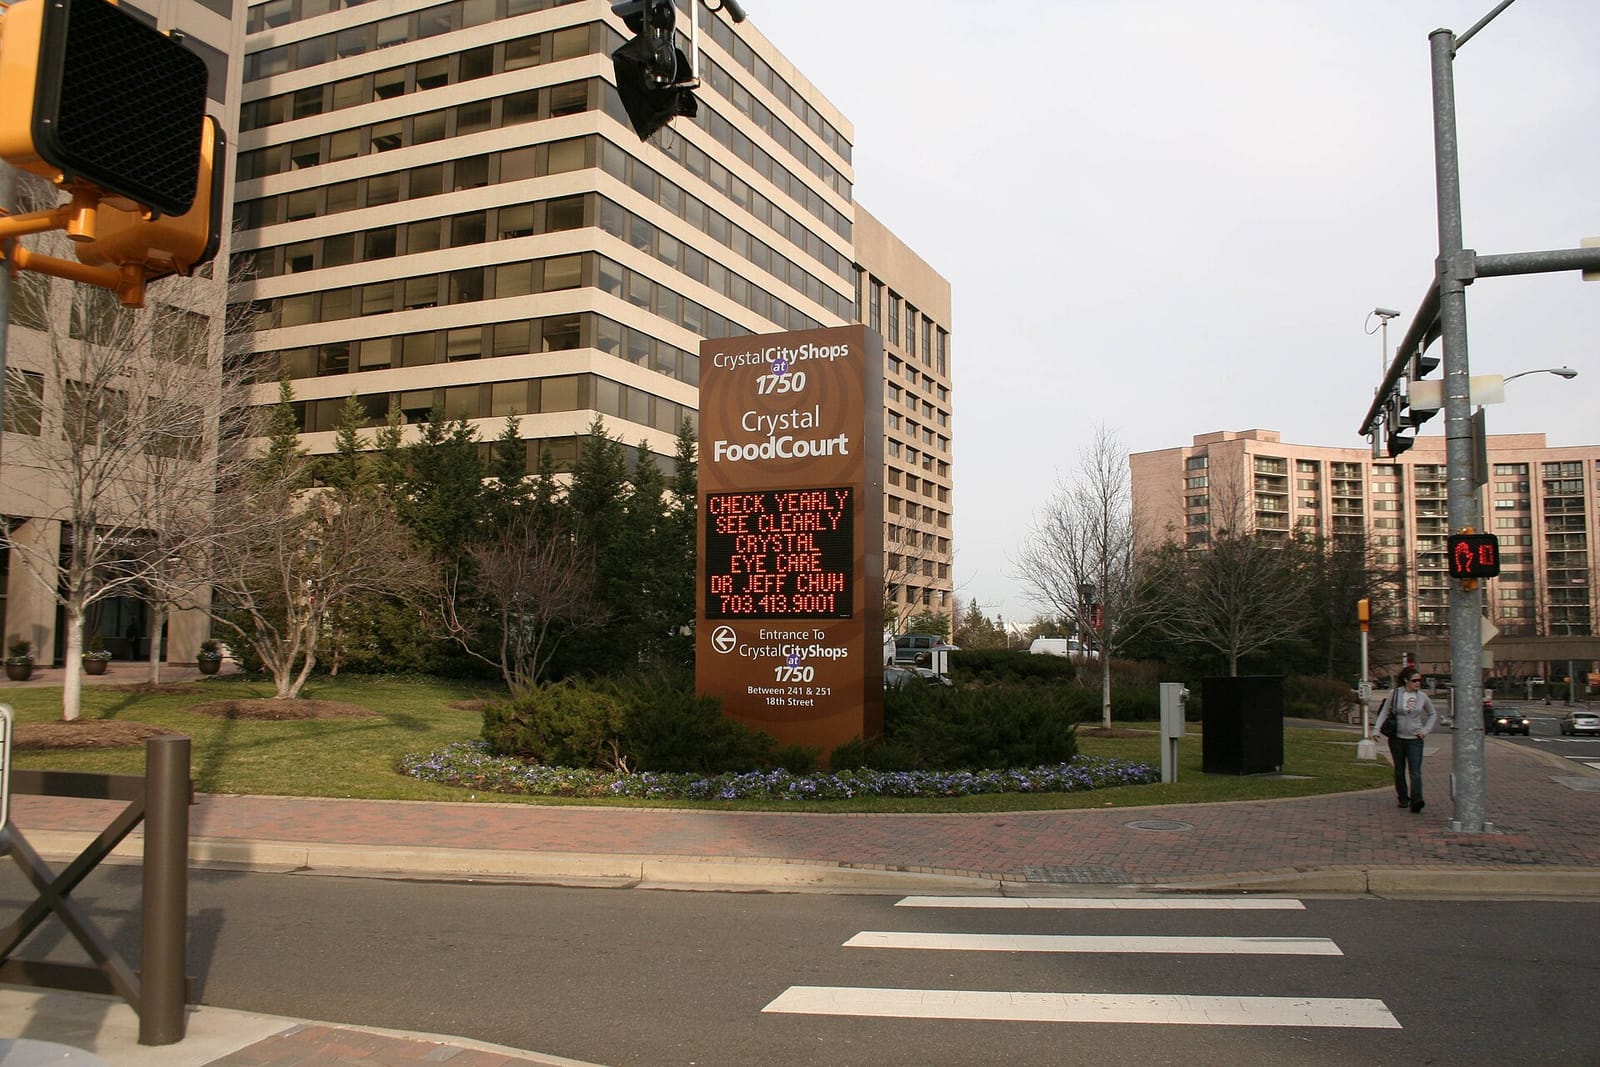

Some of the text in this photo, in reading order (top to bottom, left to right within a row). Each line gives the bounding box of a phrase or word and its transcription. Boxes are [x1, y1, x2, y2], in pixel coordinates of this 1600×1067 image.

[713, 343, 849, 370] CrystalCityShops
[772, 362, 786, 372] at
[755, 371, 806, 395] 1750
[741, 404, 820, 436] Crystal
[713, 433, 849, 463] FoodCourt
[710, 490, 849, 514] CHECK YEARLY
[716, 511, 841, 534] SEE CLEARLY
[735, 533, 820, 553] CRYSTAL
[731, 552, 822, 573] EYE CARE
[711, 573, 844, 593] DR JEFF CHUH
[720, 594, 835, 613] 703.413.9001
[759, 628, 825, 640] Entrance To
[739, 644, 849, 661] CrystalCityShops
[788, 656, 799, 665] at
[774, 665, 815, 683] 1750
[747, 686, 832, 696] Between 241 & 251
[765, 697, 814, 707] 18th Street
